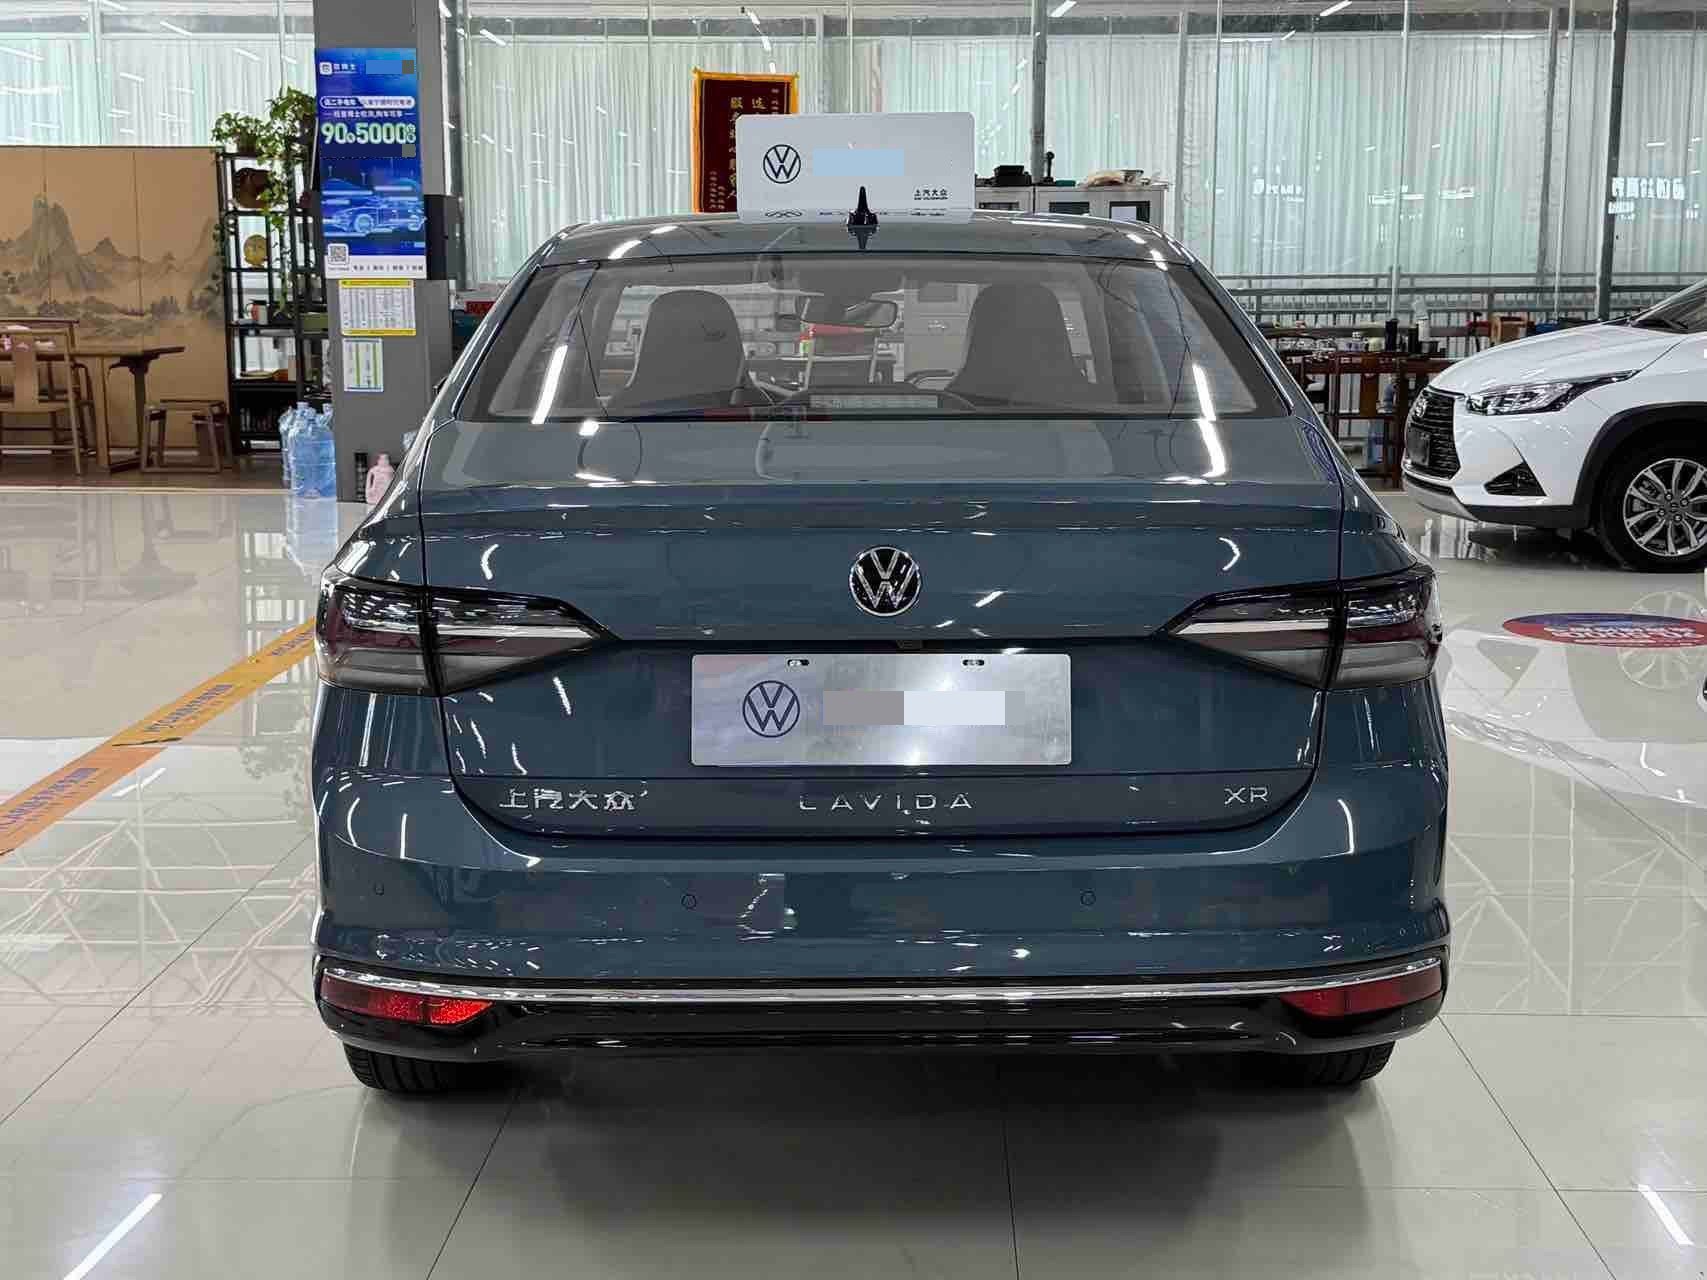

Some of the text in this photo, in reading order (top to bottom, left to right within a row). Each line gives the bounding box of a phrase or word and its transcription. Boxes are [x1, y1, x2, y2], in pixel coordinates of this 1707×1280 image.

[849, 546, 921, 616] VW
[742, 680, 800, 738] VW
[499, 788, 634, 810] 上汽大众
[800, 794, 973, 811] LAVIDA
[1224, 786, 1269, 804] XR
